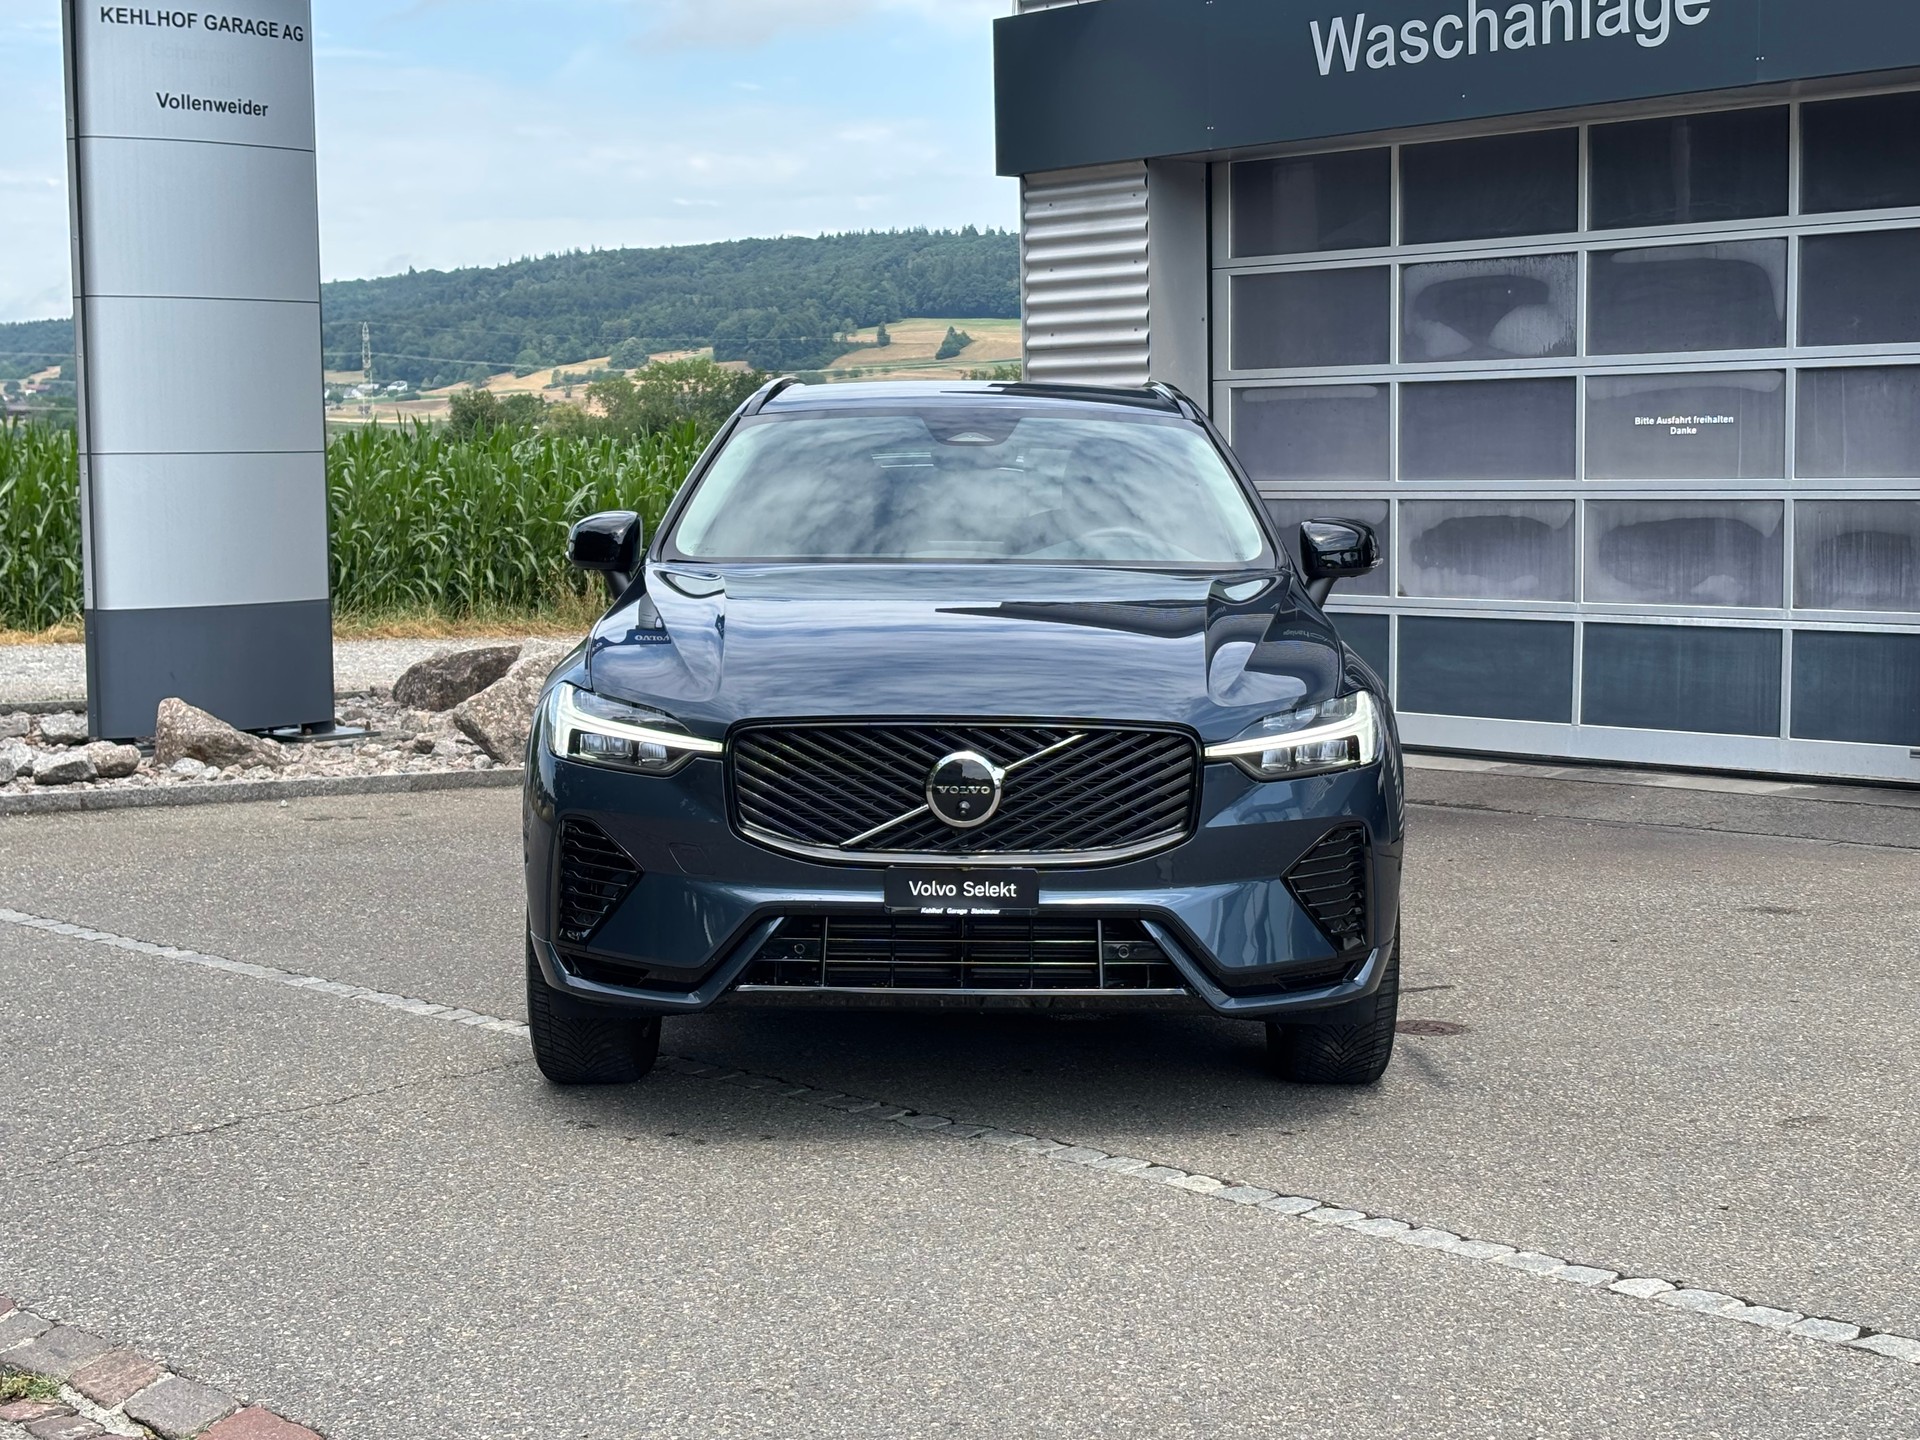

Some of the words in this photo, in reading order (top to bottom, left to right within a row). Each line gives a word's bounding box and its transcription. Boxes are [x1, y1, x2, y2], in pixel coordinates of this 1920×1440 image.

[100, 6, 198, 29] KEHLHOF
[203, 14, 280, 39] GARAGE
[282, 24, 304, 42] AG
[1309, 0, 1711, 76] Waschanlage
[155, 91, 269, 117] Vollenweider
[1634, 416, 1655, 426] Bitte
[1656, 415, 1692, 425] Ausfahrt
[1693, 415, 1734, 424] freihalten
[1669, 426, 1697, 435] Danke
[936, 785, 991, 795] VOLVO
[908, 880, 957, 897] Volvo
[962, 880, 1017, 898] Selekt
[946, 907, 968, 916] Garage
